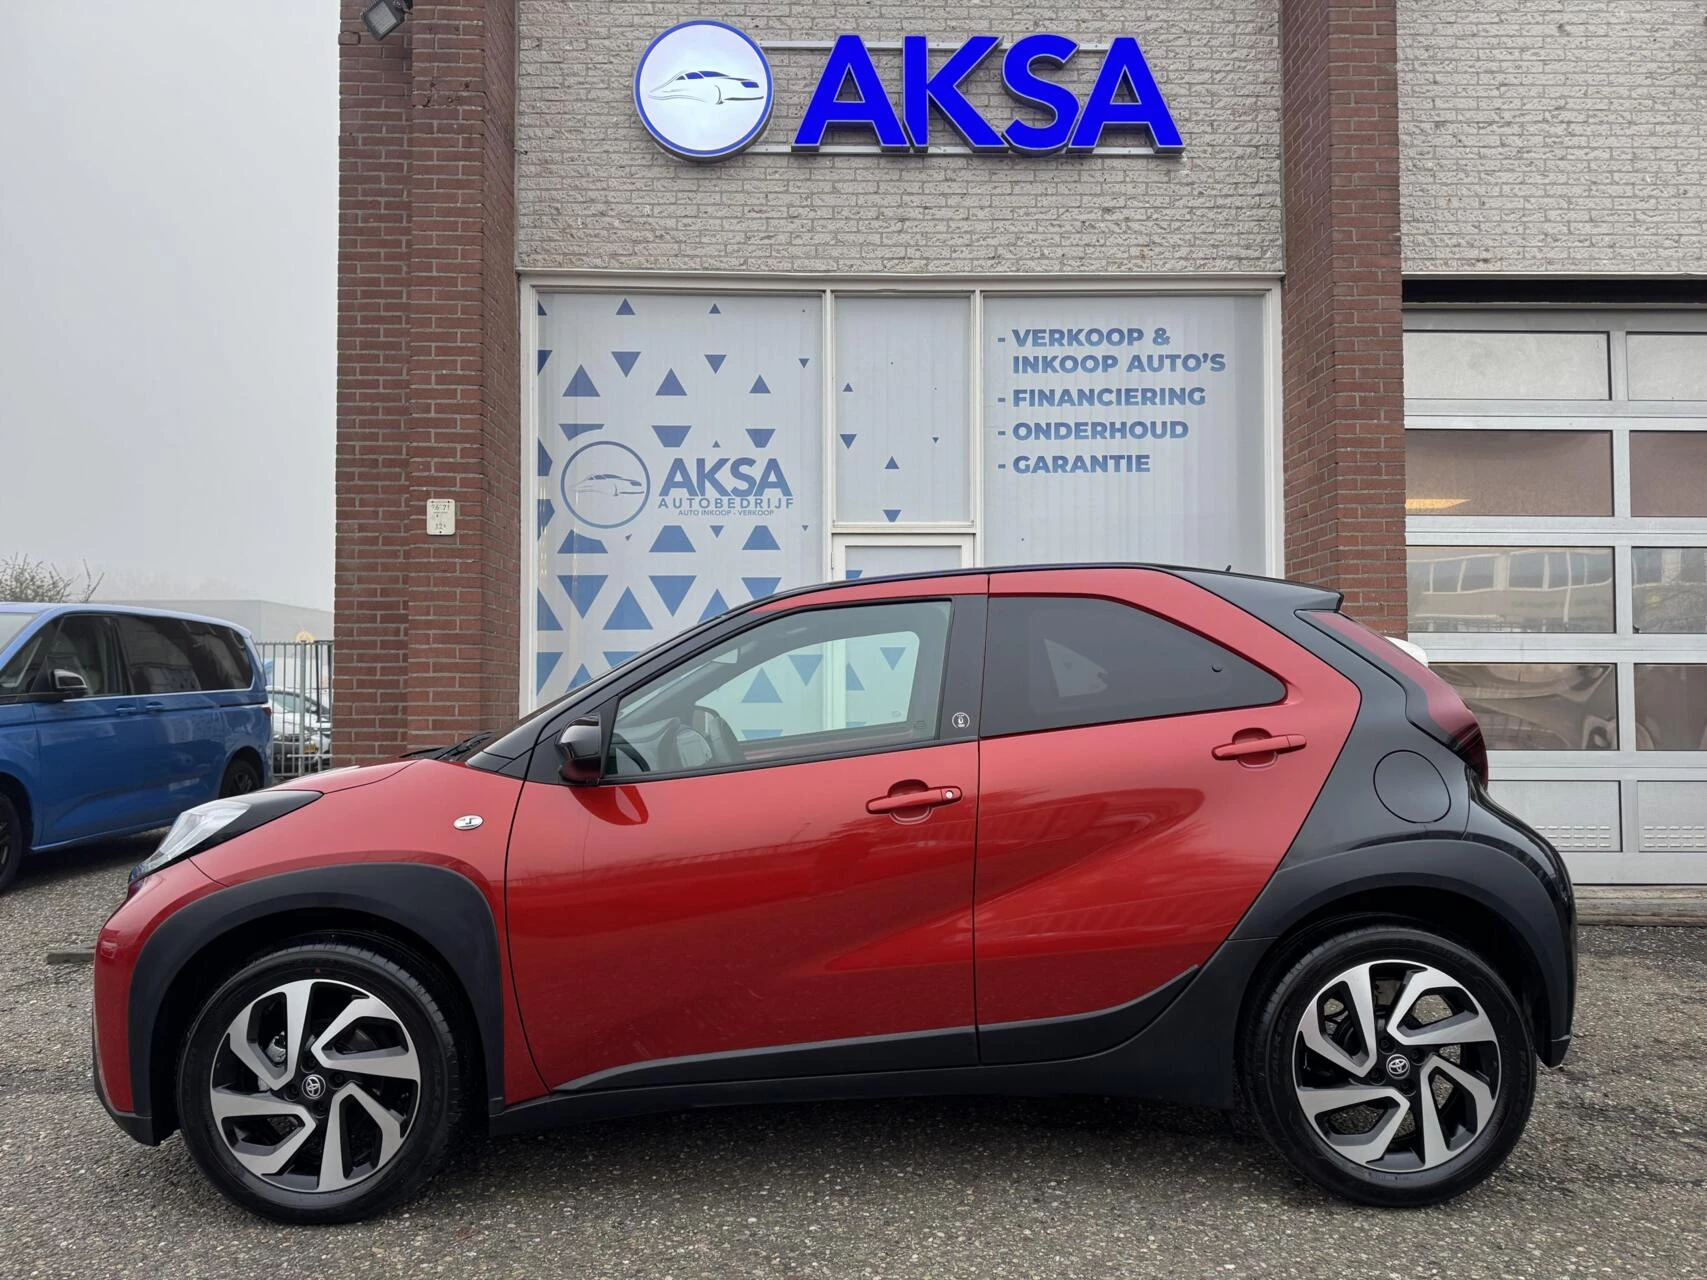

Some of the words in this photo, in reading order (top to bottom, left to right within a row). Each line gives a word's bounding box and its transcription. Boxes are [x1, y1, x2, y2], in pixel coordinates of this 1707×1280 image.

[791, 34, 1183, 154] AKSA
[1012, 328, 1144, 347] VERKOOP
[1152, 327, 1171, 346] &
[1012, 354, 1119, 374] INKOOP
[1126, 353, 1226, 373] AUTO'S
[1012, 387, 1206, 407] FINANCIERING
[1012, 420, 1189, 441] ONDERHOUD
[1012, 454, 1151, 474] GARANTIE
[659, 457, 793, 498] AKSA
[658, 497, 794, 509] AUTOBEDRIJF
[678, 509, 699, 517] AUTO
[701, 509, 732, 517] INKOOP
[737, 509, 775, 517] VERKOOP
